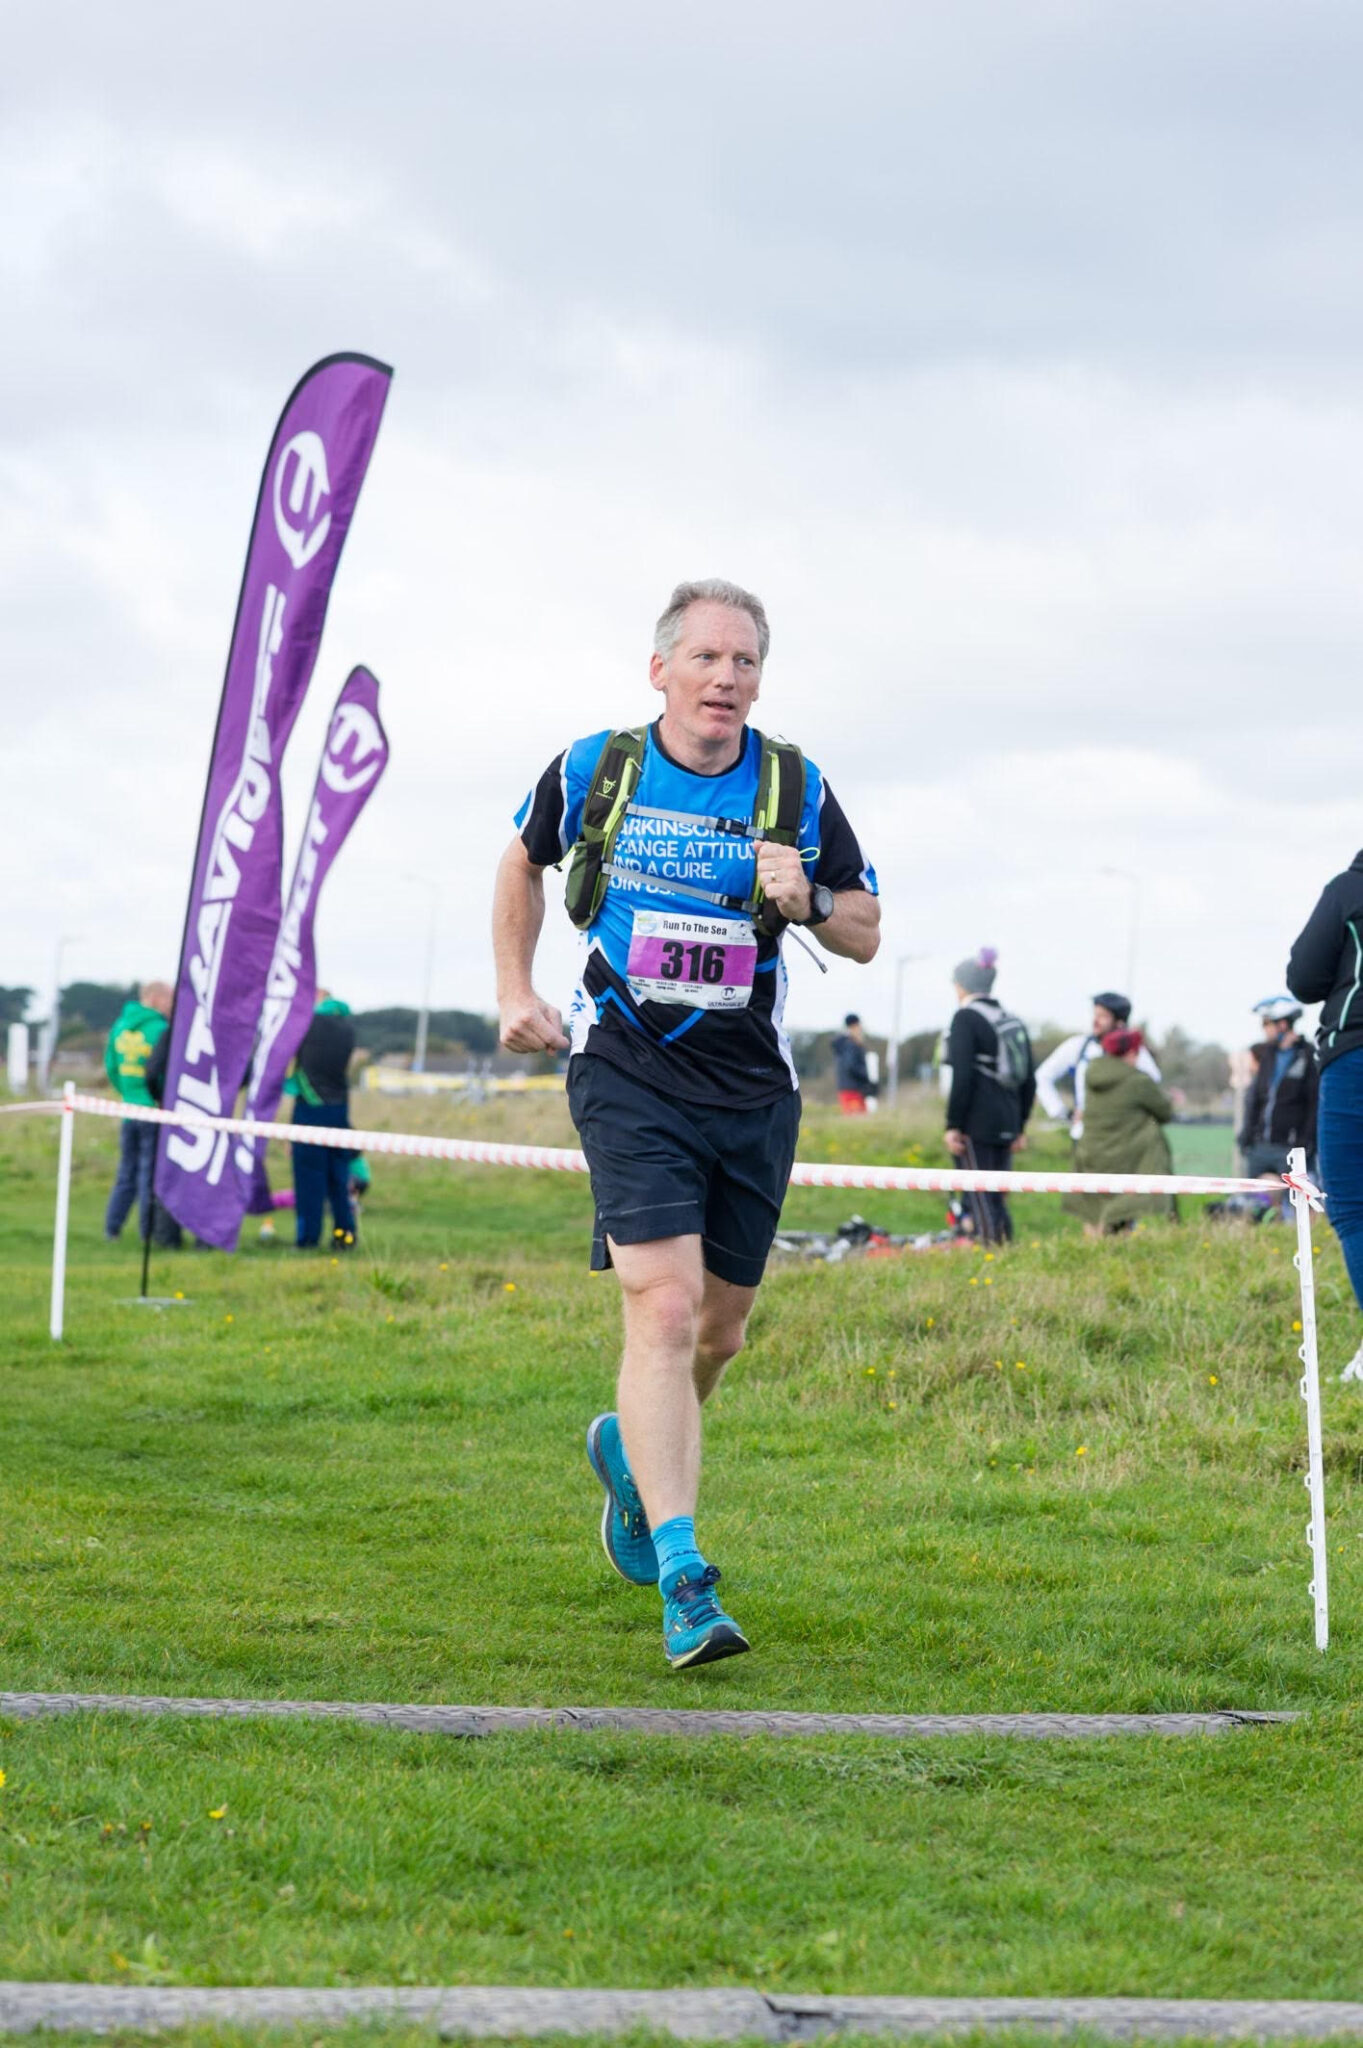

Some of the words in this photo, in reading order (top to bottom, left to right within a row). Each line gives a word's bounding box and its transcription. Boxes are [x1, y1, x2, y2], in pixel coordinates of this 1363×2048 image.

[615, 838, 678, 858] ANGE
[613, 855, 642, 875] IND
[646, 861, 659, 876] A
[662, 861, 717, 880] CURE.
[608, 874, 641, 892] OIN
[663, 920, 680, 929] Run
[682, 922, 692, 931] To
[694, 923, 709, 934] The
[711, 924, 728, 935] Sea
[660, 941, 726, 984] 316
